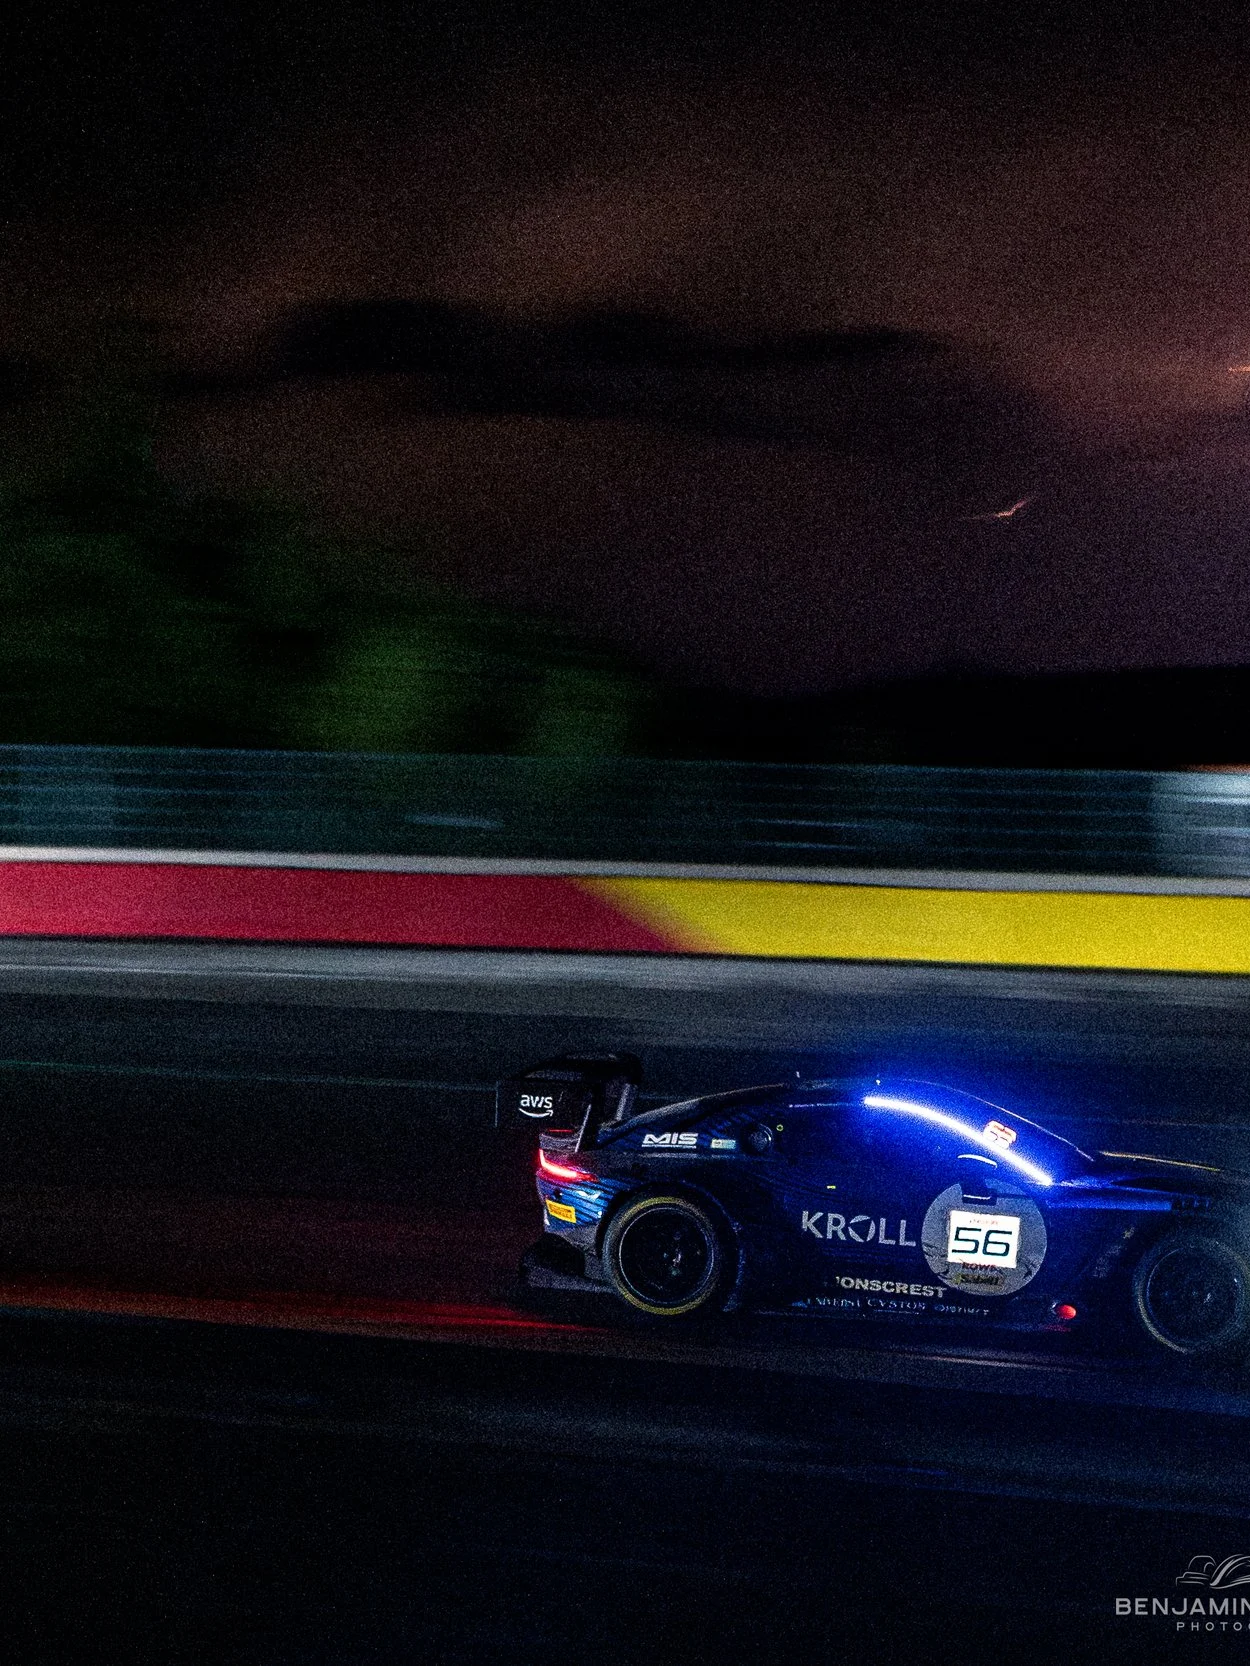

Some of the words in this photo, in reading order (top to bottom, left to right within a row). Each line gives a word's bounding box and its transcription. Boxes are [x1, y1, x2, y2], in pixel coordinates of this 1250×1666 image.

[520, 1094, 553, 1109] aws
[642, 1131, 699, 1145] MIS
[801, 1210, 917, 1247] KROLL
[951, 1226, 1013, 1257] 56
[835, 1276, 947, 1298] ONSCREST
